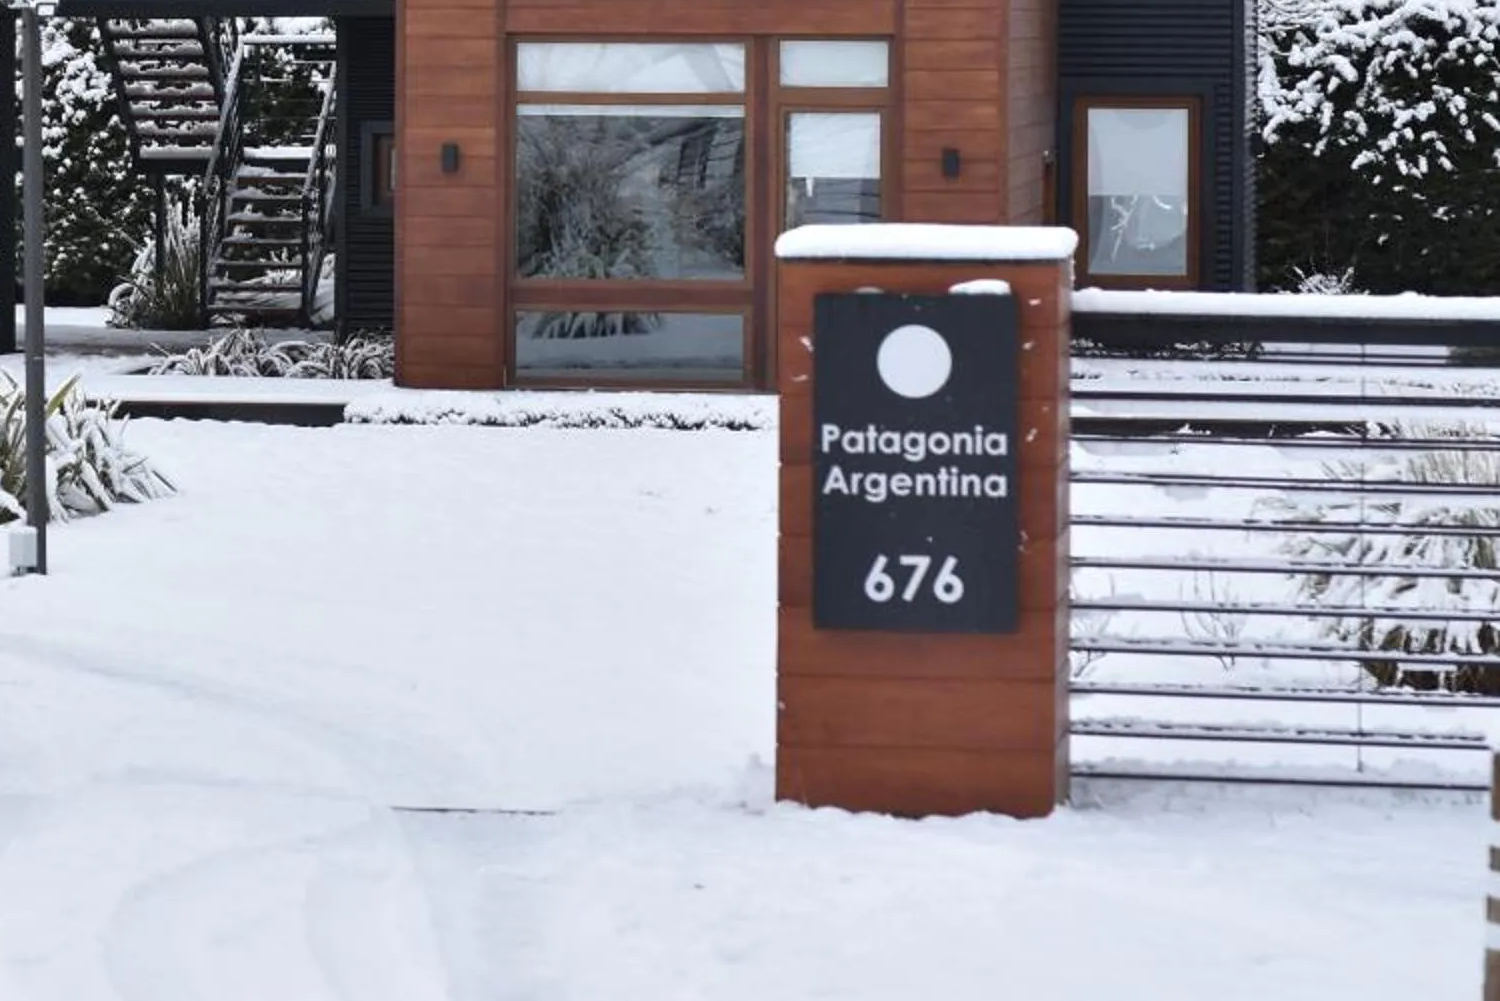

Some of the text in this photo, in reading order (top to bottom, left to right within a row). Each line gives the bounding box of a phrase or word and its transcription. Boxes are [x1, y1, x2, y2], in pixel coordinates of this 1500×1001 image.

[821, 424, 1008, 462] Patagonia
[822, 465, 1008, 503] Argentina
[863, 554, 965, 603] 676
